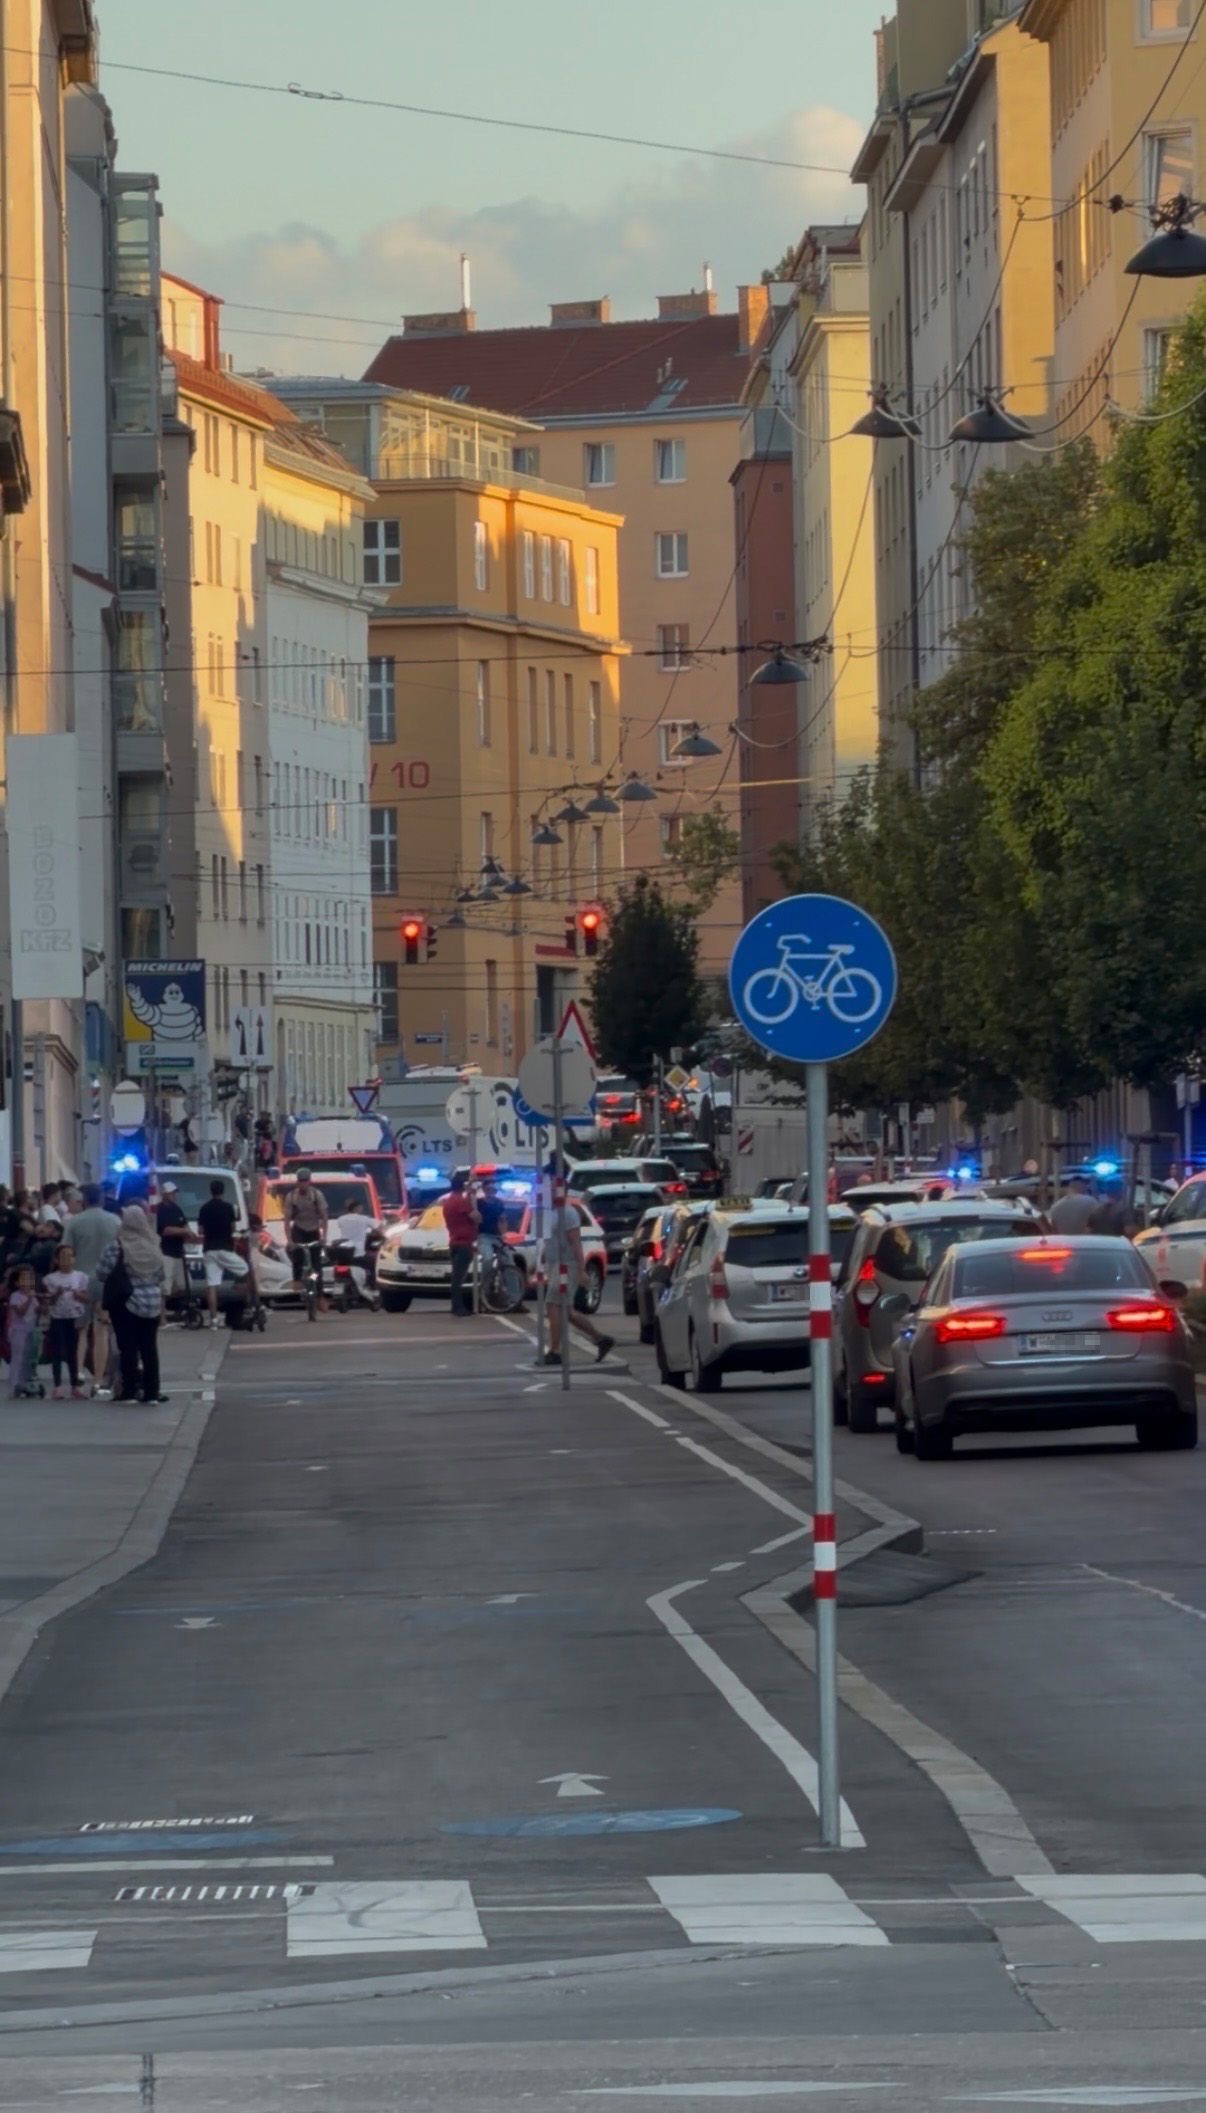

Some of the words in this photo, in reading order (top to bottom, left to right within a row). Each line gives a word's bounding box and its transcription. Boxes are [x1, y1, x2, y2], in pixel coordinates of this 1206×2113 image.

[391, 761, 430, 789] 10
[127, 962, 203, 973] MICHELIN
[422, 1139, 453, 1153] LTS
